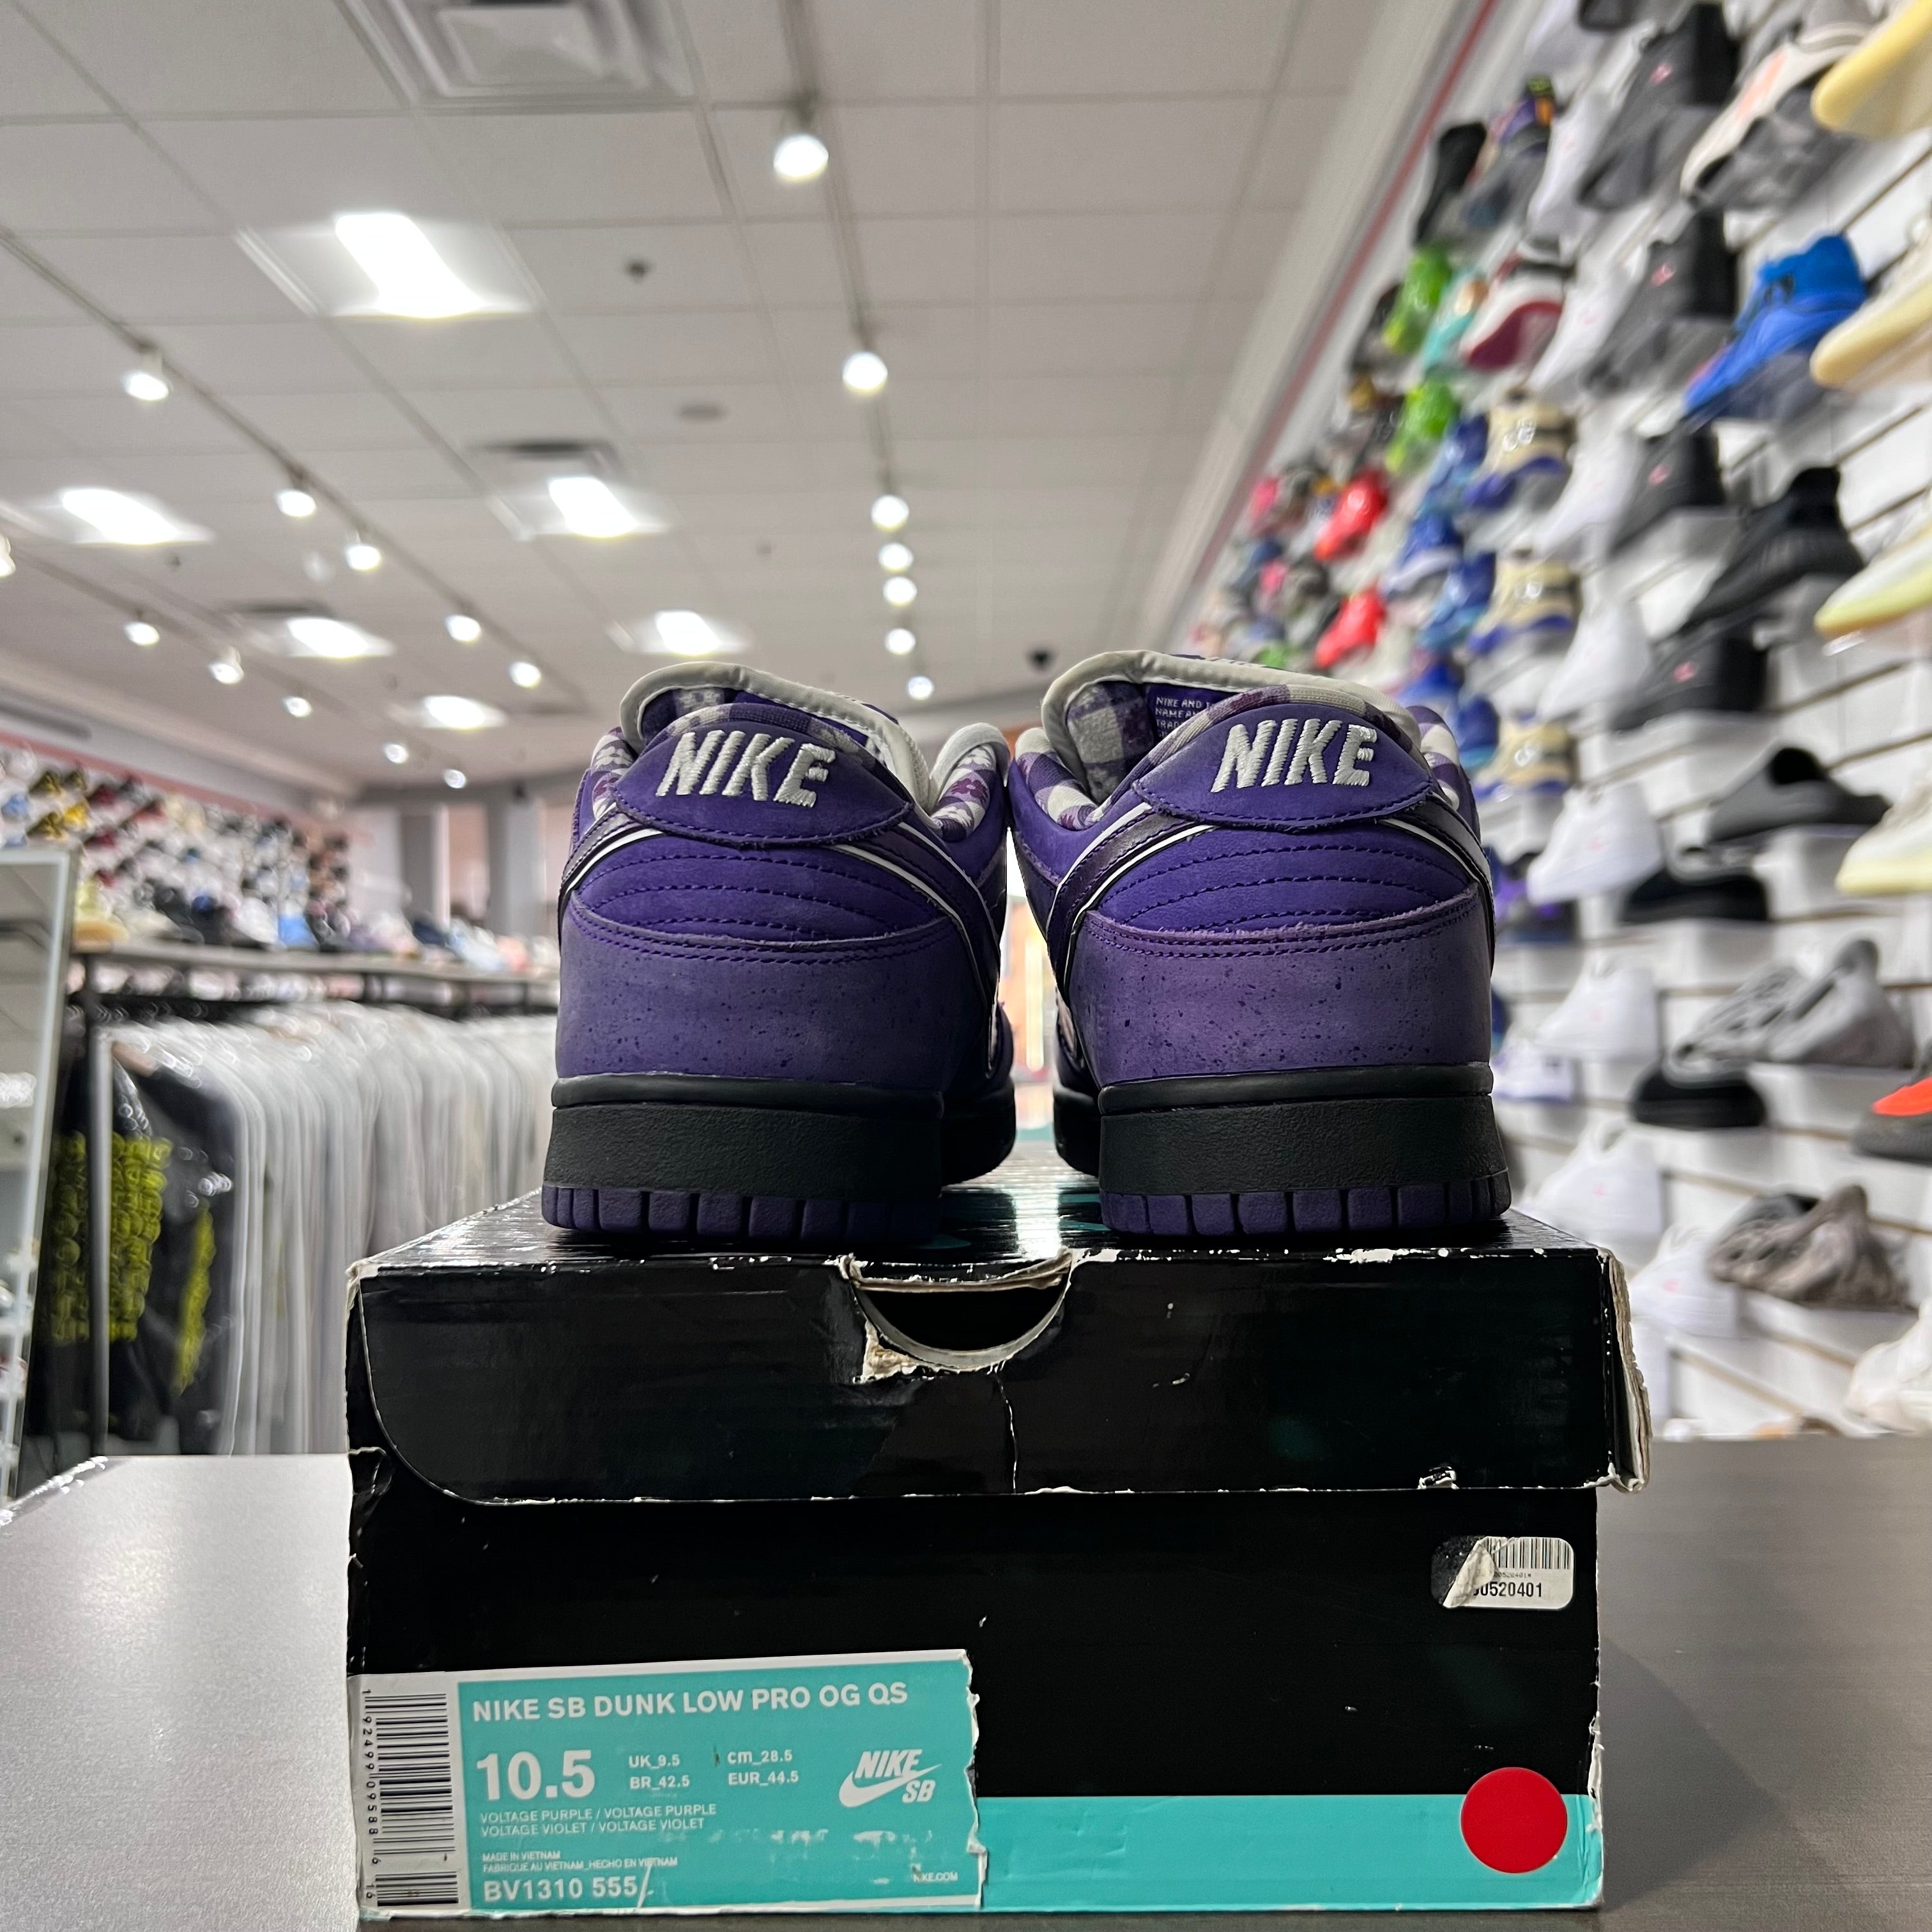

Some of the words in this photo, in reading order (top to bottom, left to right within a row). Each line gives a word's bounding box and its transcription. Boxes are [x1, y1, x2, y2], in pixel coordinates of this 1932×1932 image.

[1156, 696, 1179, 708] NIKE
[1181, 699, 1202, 709] AND
[1155, 707, 1184, 718] NAME
[1211, 718, 1377, 793] NIKE
[656, 730, 836, 808] NIKE
[473, 1699, 540, 1722] NIKE
[548, 1697, 586, 1719] SB
[594, 1692, 676, 1717] DUNK
[683, 1689, 744, 1713] LOW
[752, 1686, 811, 1710] PRO
[819, 1683, 861, 1707] OG
[868, 1682, 908, 1705] QS
[629, 1754, 680, 1770] UK_9.5
[727, 1749, 793, 1766] cm_28.5
[854, 1749, 923, 1779] NIKE
[477, 1749, 595, 1801] 10.5
[630, 1775, 690, 1791] BR_42.5
[728, 1770, 799, 1786] EUR_44.5
[901, 1780, 936, 1803] SB
[480, 1810, 537, 1824] VOLTAGE
[542, 1808, 592, 1821] PURPLE
[604, 1806, 661, 1819] VOLTAGE
[665, 1804, 717, 1816] PURPLE
[482, 1823, 538, 1837] VOLTAGE
[542, 1822, 586, 1834] VIOLET
[599, 1820, 656, 1832] VOLTAGE
[660, 1818, 705, 1830] VIOLET
[482, 1853, 509, 1862] MADE
[510, 1852, 519, 1860] IN
[521, 1851, 561, 1860] VIETNAM
[483, 1862, 530, 1873] FABRIQUE
[530, 1862, 543, 1871] AU
[624, 1859, 637, 1868] EN
[483, 1878, 583, 1903] BV1310
[592, 1875, 638, 1897] 555
